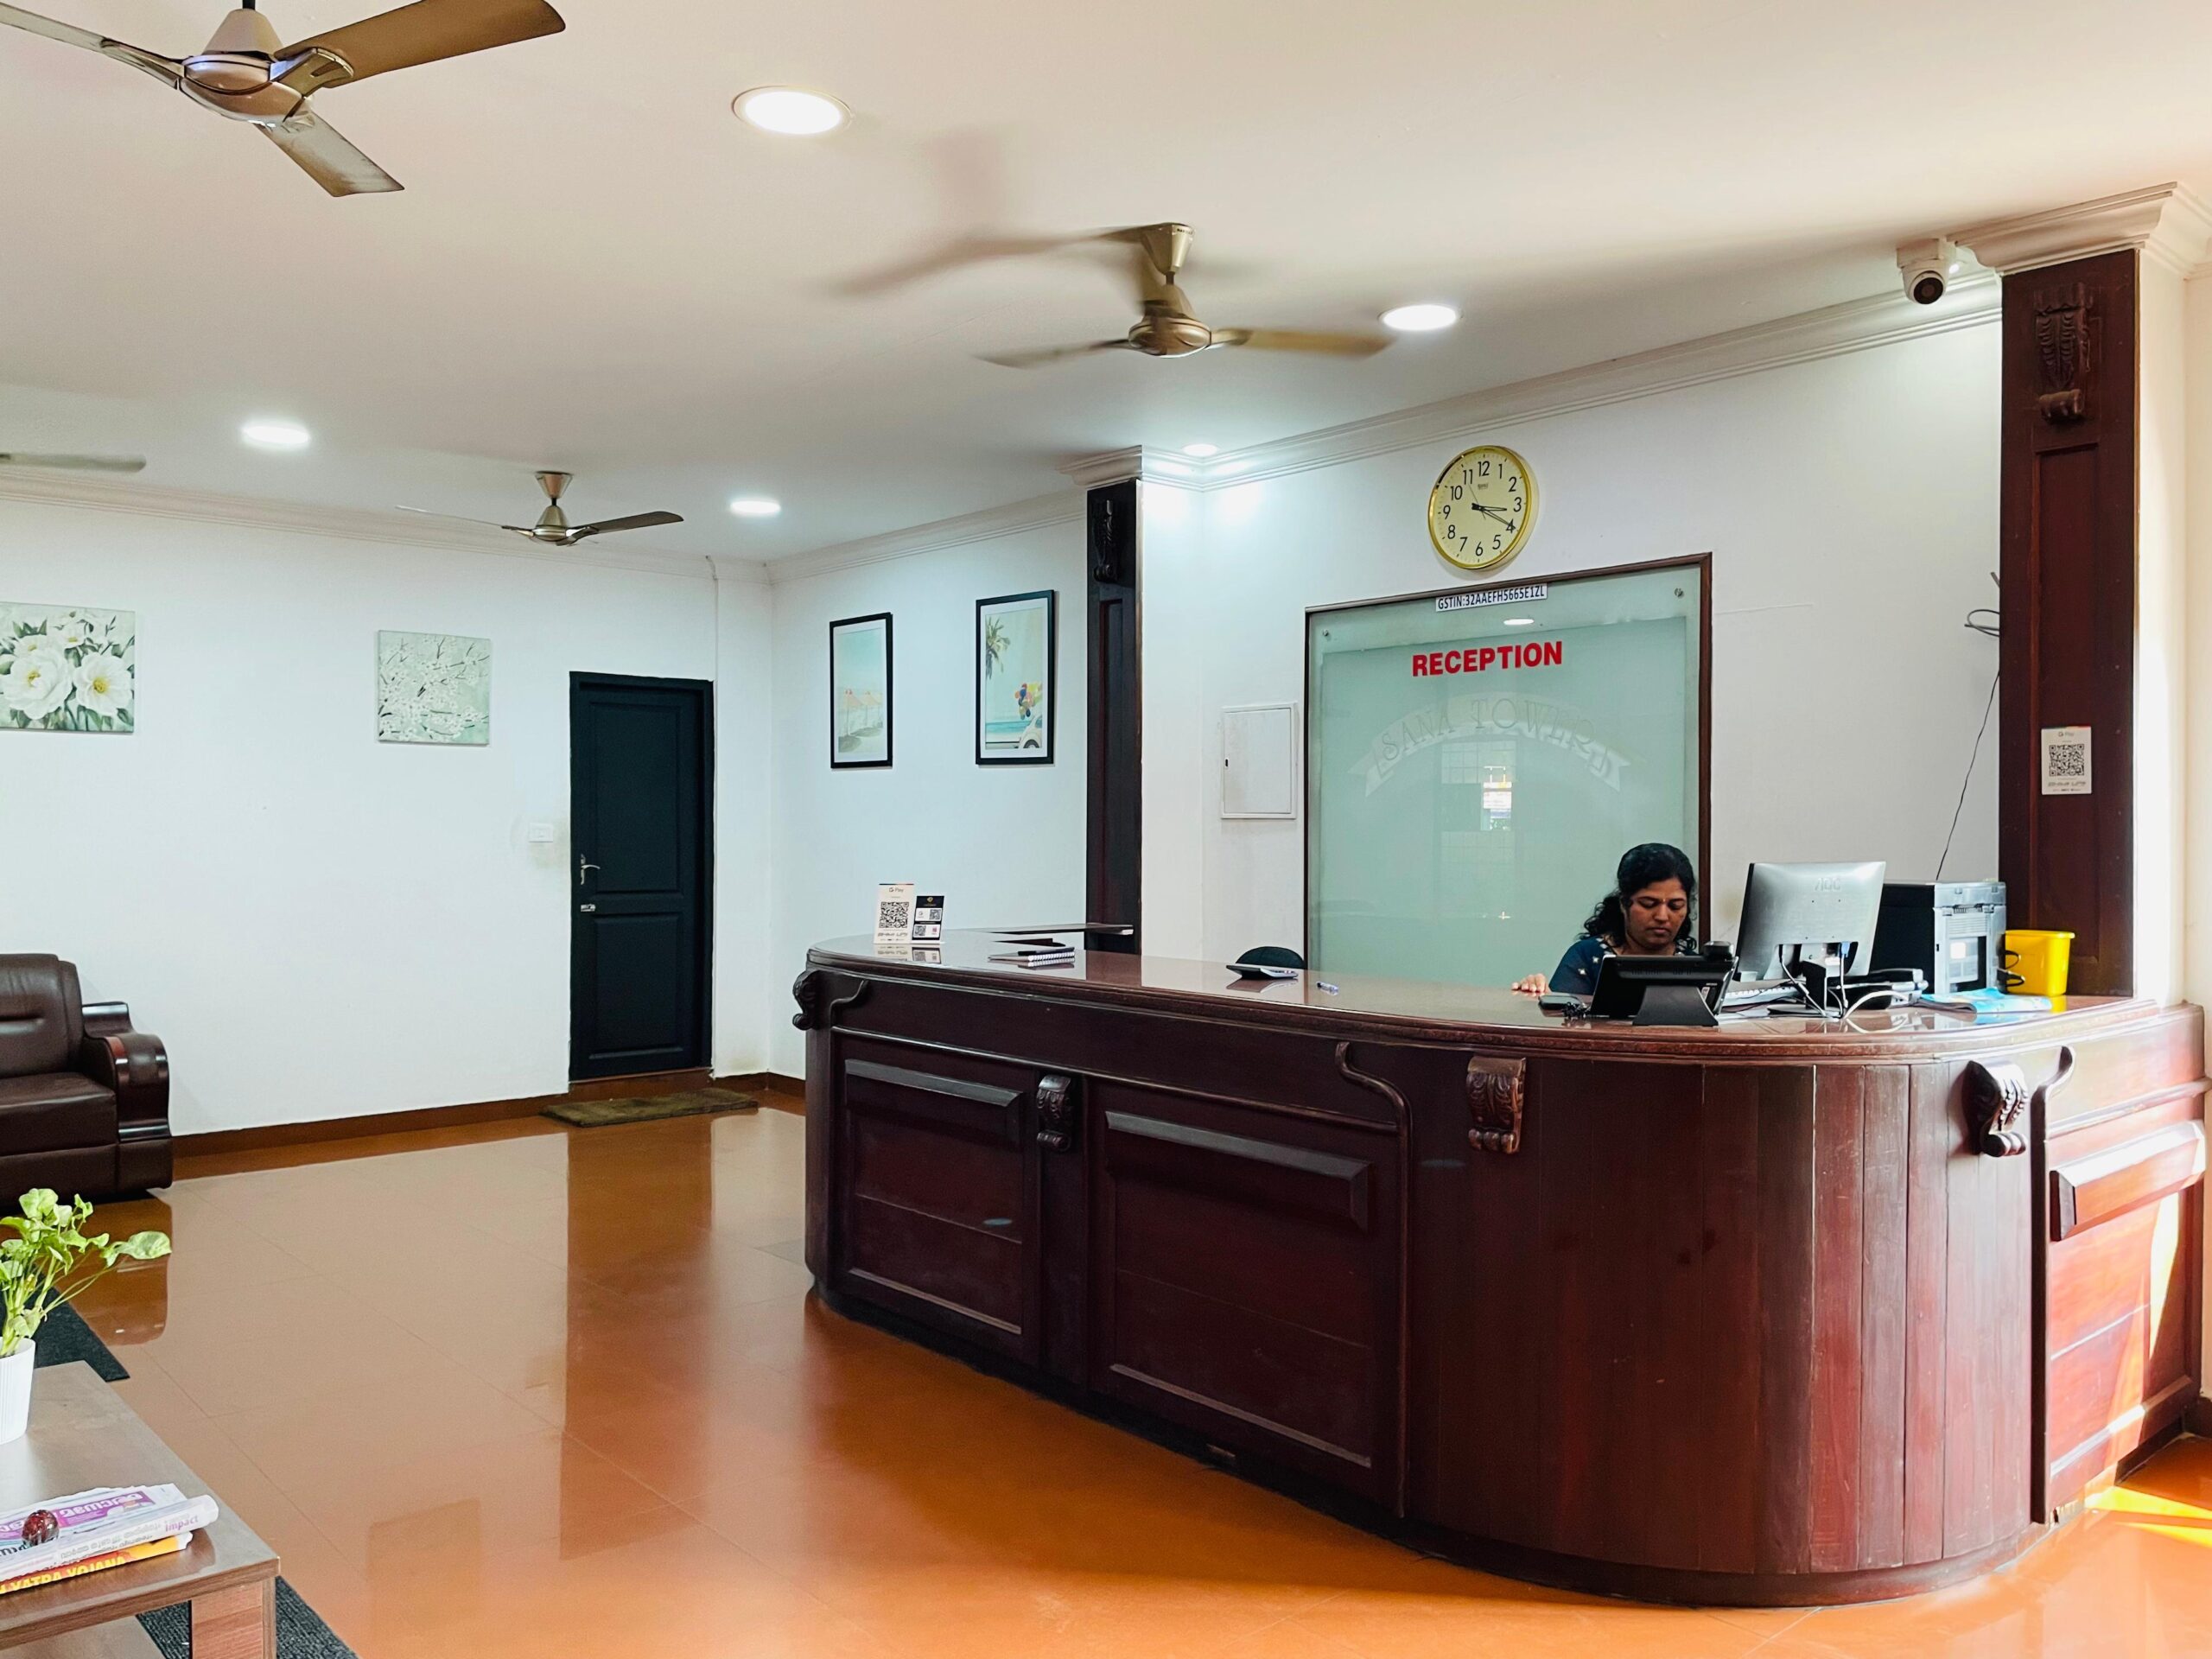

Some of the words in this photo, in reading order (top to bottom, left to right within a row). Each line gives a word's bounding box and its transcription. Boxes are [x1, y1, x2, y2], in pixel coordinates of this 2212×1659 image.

[1463, 469, 1473, 485] 11
[1478, 461, 1491, 477] 12
[1509, 476, 1517, 492] 2
[1451, 485, 1463, 500] 10
[1443, 505, 1451, 520] 9
[1513, 497, 1522, 512] 3
[1447, 524, 1456, 539] 8
[1505, 518, 1516, 534] 4
[1459, 537, 1468, 552] 7
[1475, 541, 1484, 556] 6
[1492, 534, 1502, 550] 5
[1438, 586, 1545, 609] GSTIN:32AAEFH5665E1ZL
[1412, 640, 1563, 677] RECEPTION
[1381, 706, 1456, 761] SANA
[165, 1515, 199, 1532] impact
